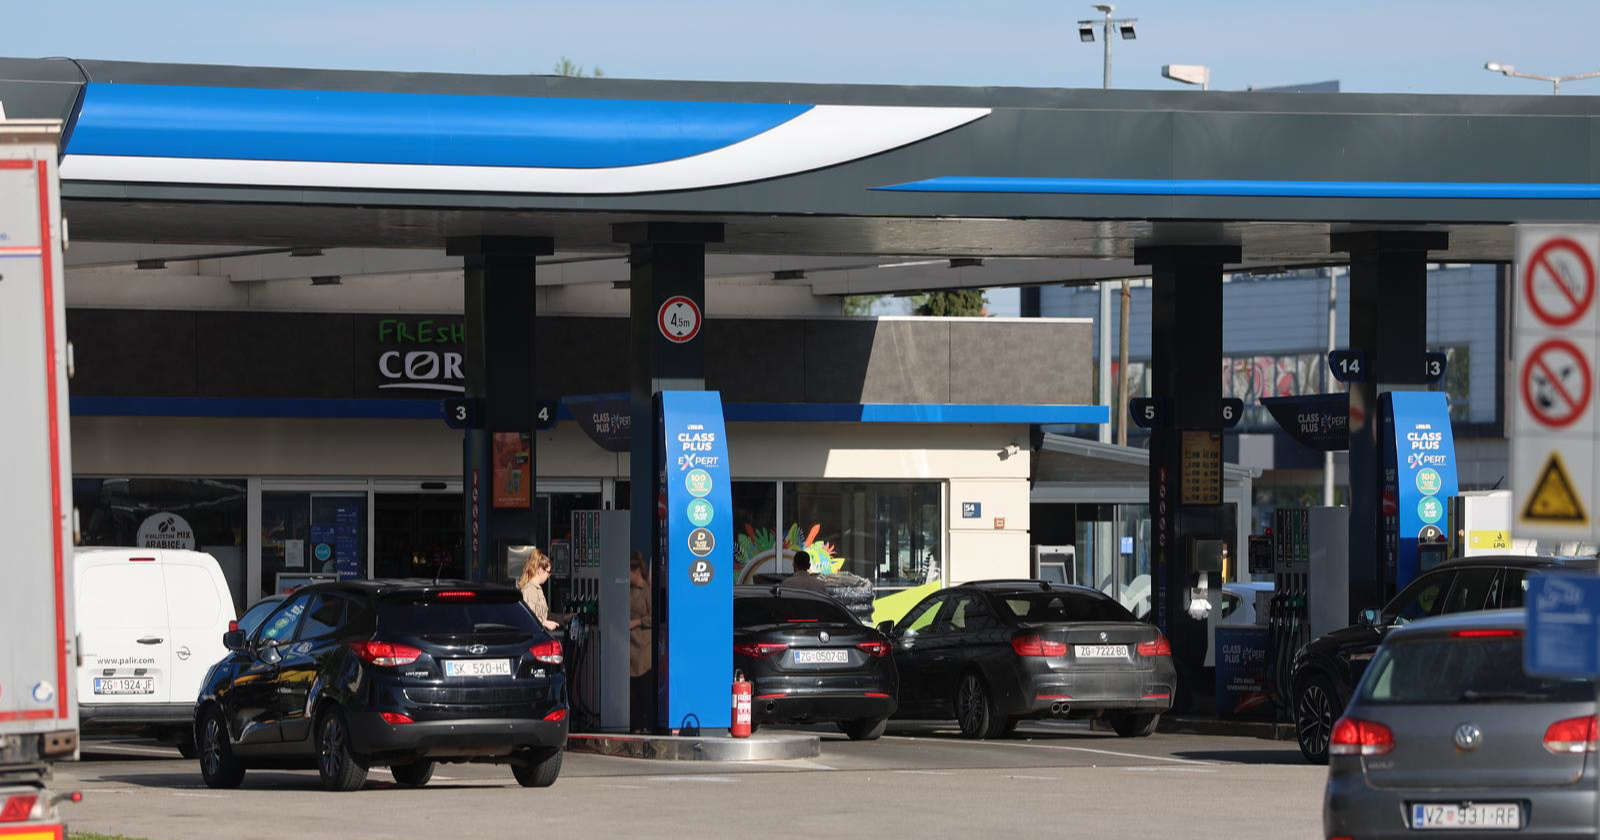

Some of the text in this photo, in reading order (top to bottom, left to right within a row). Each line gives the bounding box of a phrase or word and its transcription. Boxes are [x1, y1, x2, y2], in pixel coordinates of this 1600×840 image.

[670, 313, 690, 328] 4,5m
[1339, 359, 1360, 374] 14
[455, 406, 467, 420] 3
[538, 407, 549, 421] 4
[1145, 406, 1155, 419] 5
[1222, 406, 1233, 420] 6
[593, 413, 610, 423] CLASS
[596, 423, 610, 433] PLUS
[1298, 413, 1347, 434] CLASS EXPERT
[1301, 423, 1318, 433] PLUS
[678, 432, 715, 442] CLASS
[1407, 432, 1442, 441] CLASS
[682, 442, 712, 451] PLUS
[1411, 441, 1440, 450] PLUS
[678, 453, 719, 471] EXPERT
[1407, 452, 1446, 469] EXPERT
[690, 474, 706, 483] 100
[1421, 473, 1436, 482] 100
[694, 505, 707, 513] 95
[965, 504, 975, 512] 54
[1424, 502, 1436, 510] 95
[177, 531, 191, 539] MIX
[697, 532, 706, 541] D
[1427, 529, 1435, 537] D
[145, 540, 181, 549] ARABICE
[696, 561, 707, 572] D
[1081, 646, 1091, 655] ZG
[1222, 644, 1241, 654] CLASS
[97, 657, 155, 666] www.palir.com
[801, 652, 811, 662] ZG
[1224, 654, 1240, 663] PLUS
[454, 664, 464, 674] SK
[102, 680, 113, 690] ZG
[1425, 807, 1444, 825] VZ
